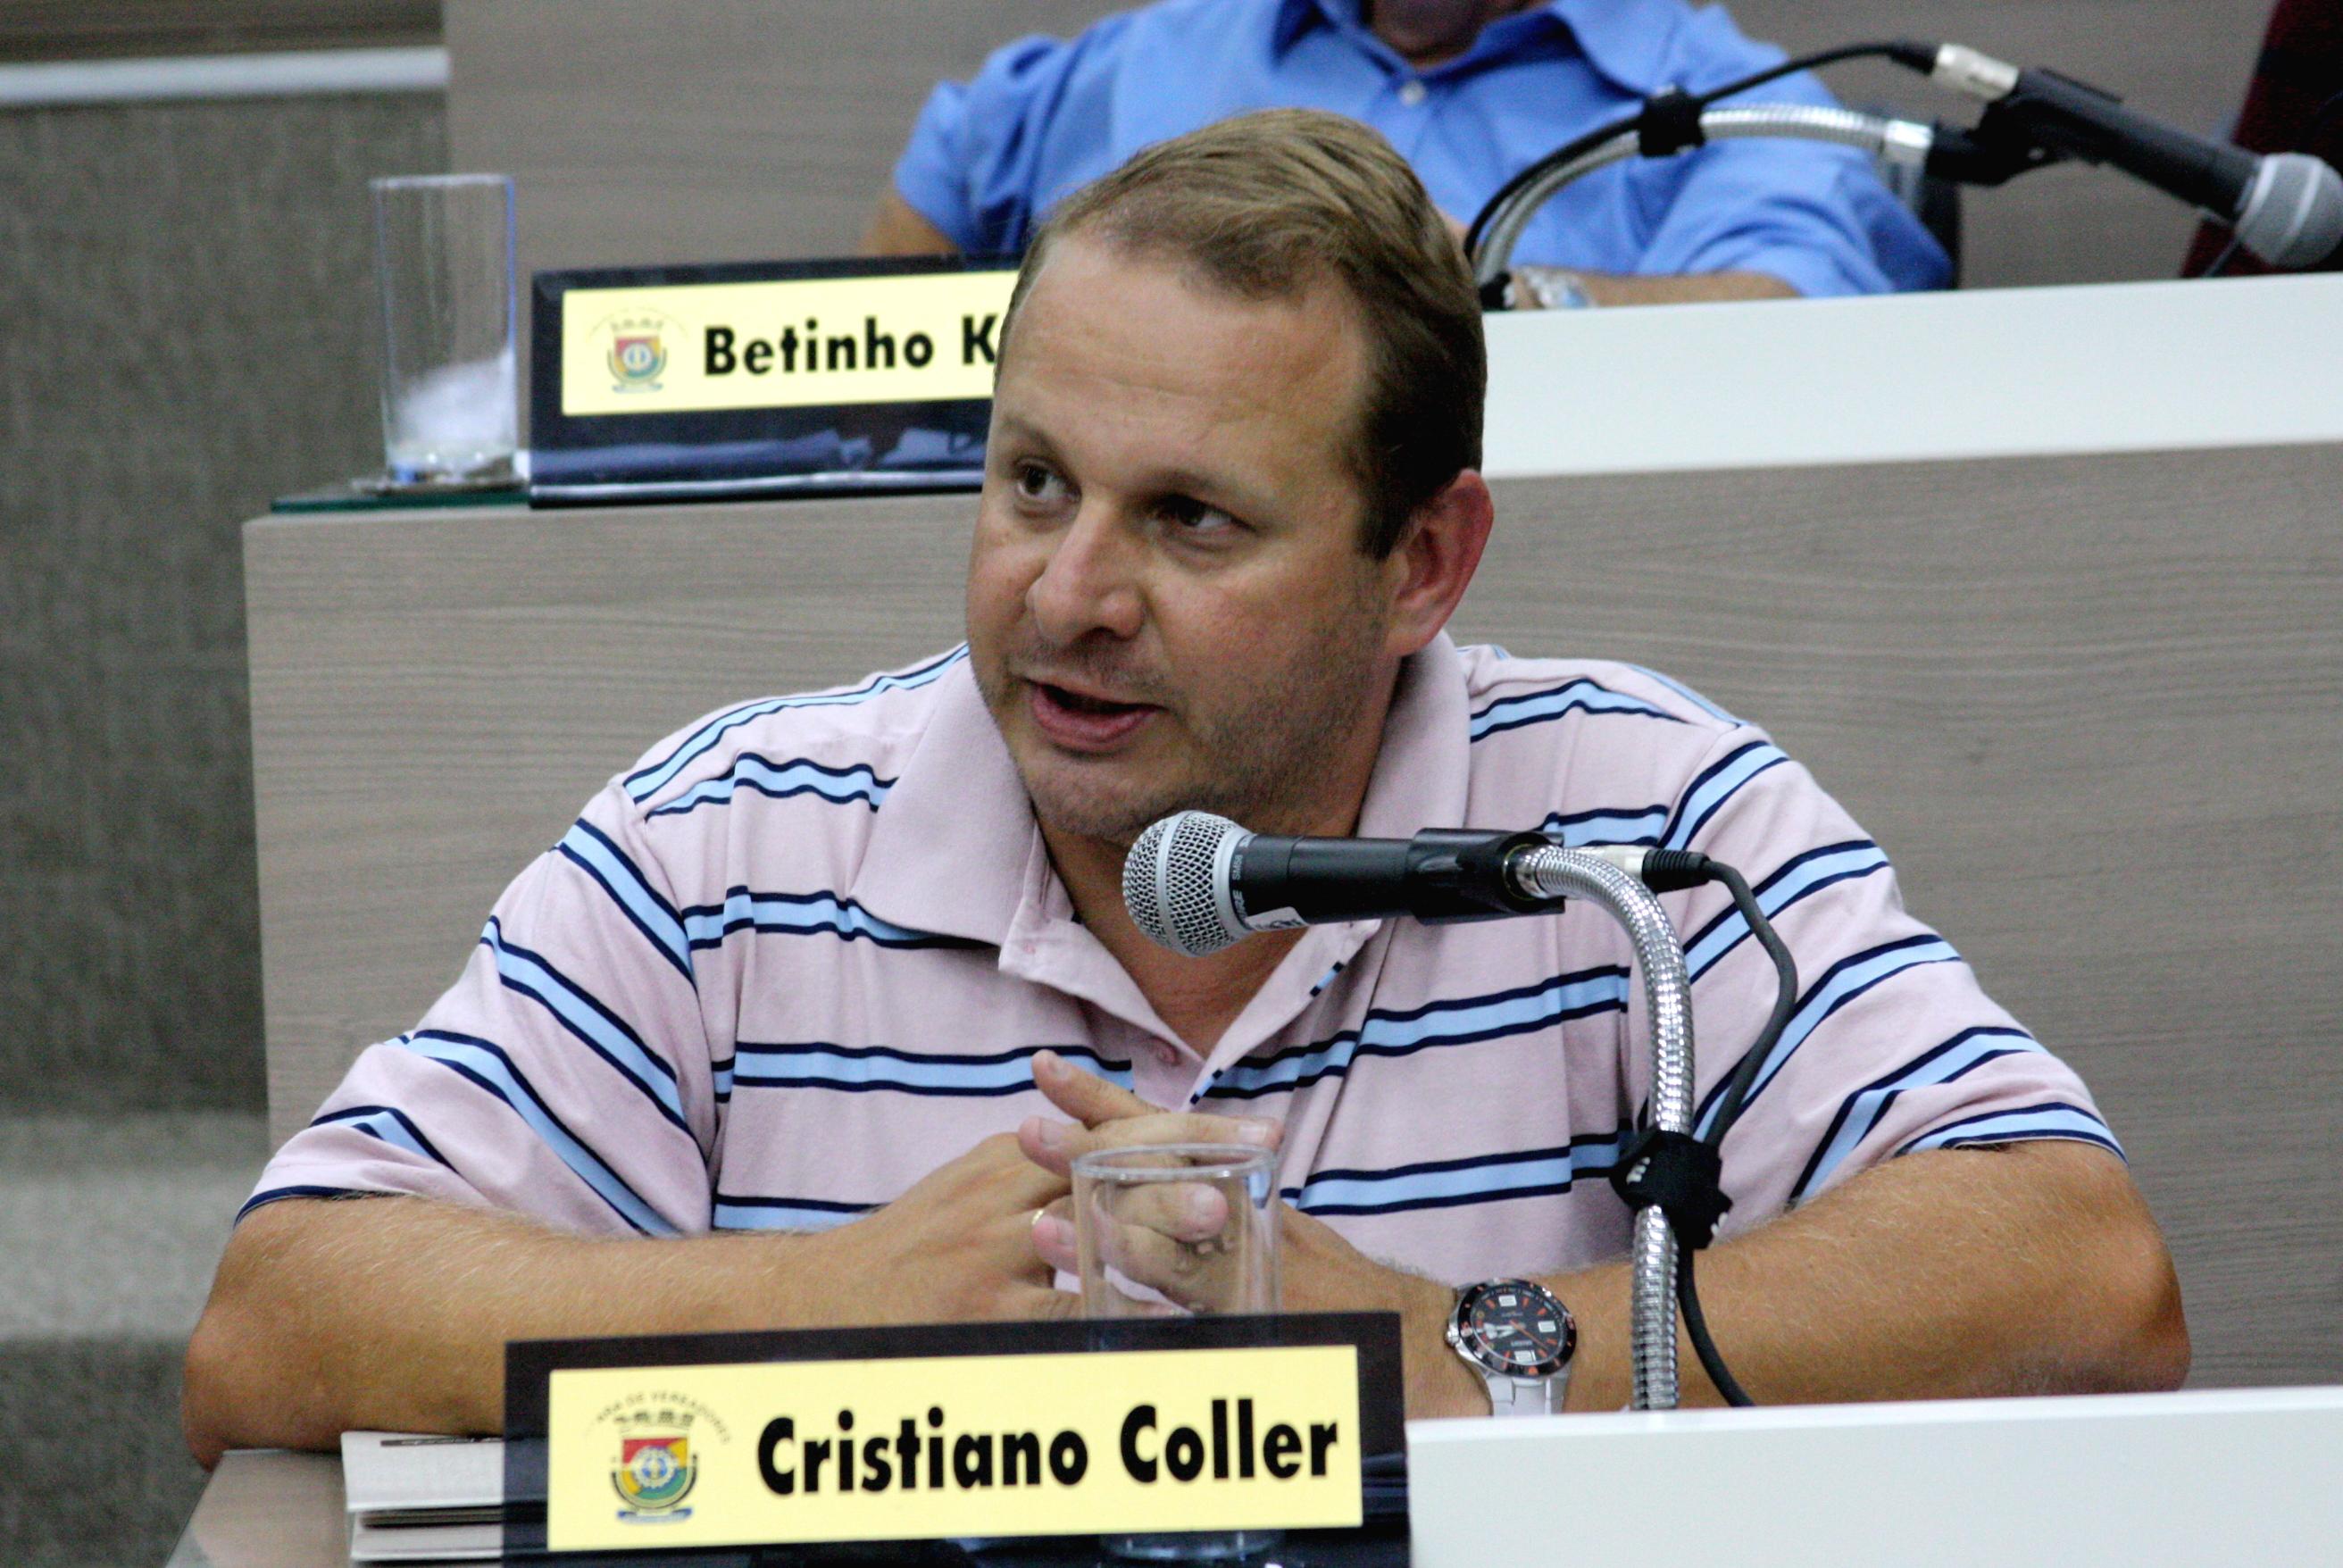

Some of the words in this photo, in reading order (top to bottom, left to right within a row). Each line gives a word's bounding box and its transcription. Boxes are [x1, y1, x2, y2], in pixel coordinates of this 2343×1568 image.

[705, 317, 934, 376] Betinho
[756, 1405, 1089, 1497] Cristiano
[1119, 1397, 1338, 1485] Coller
